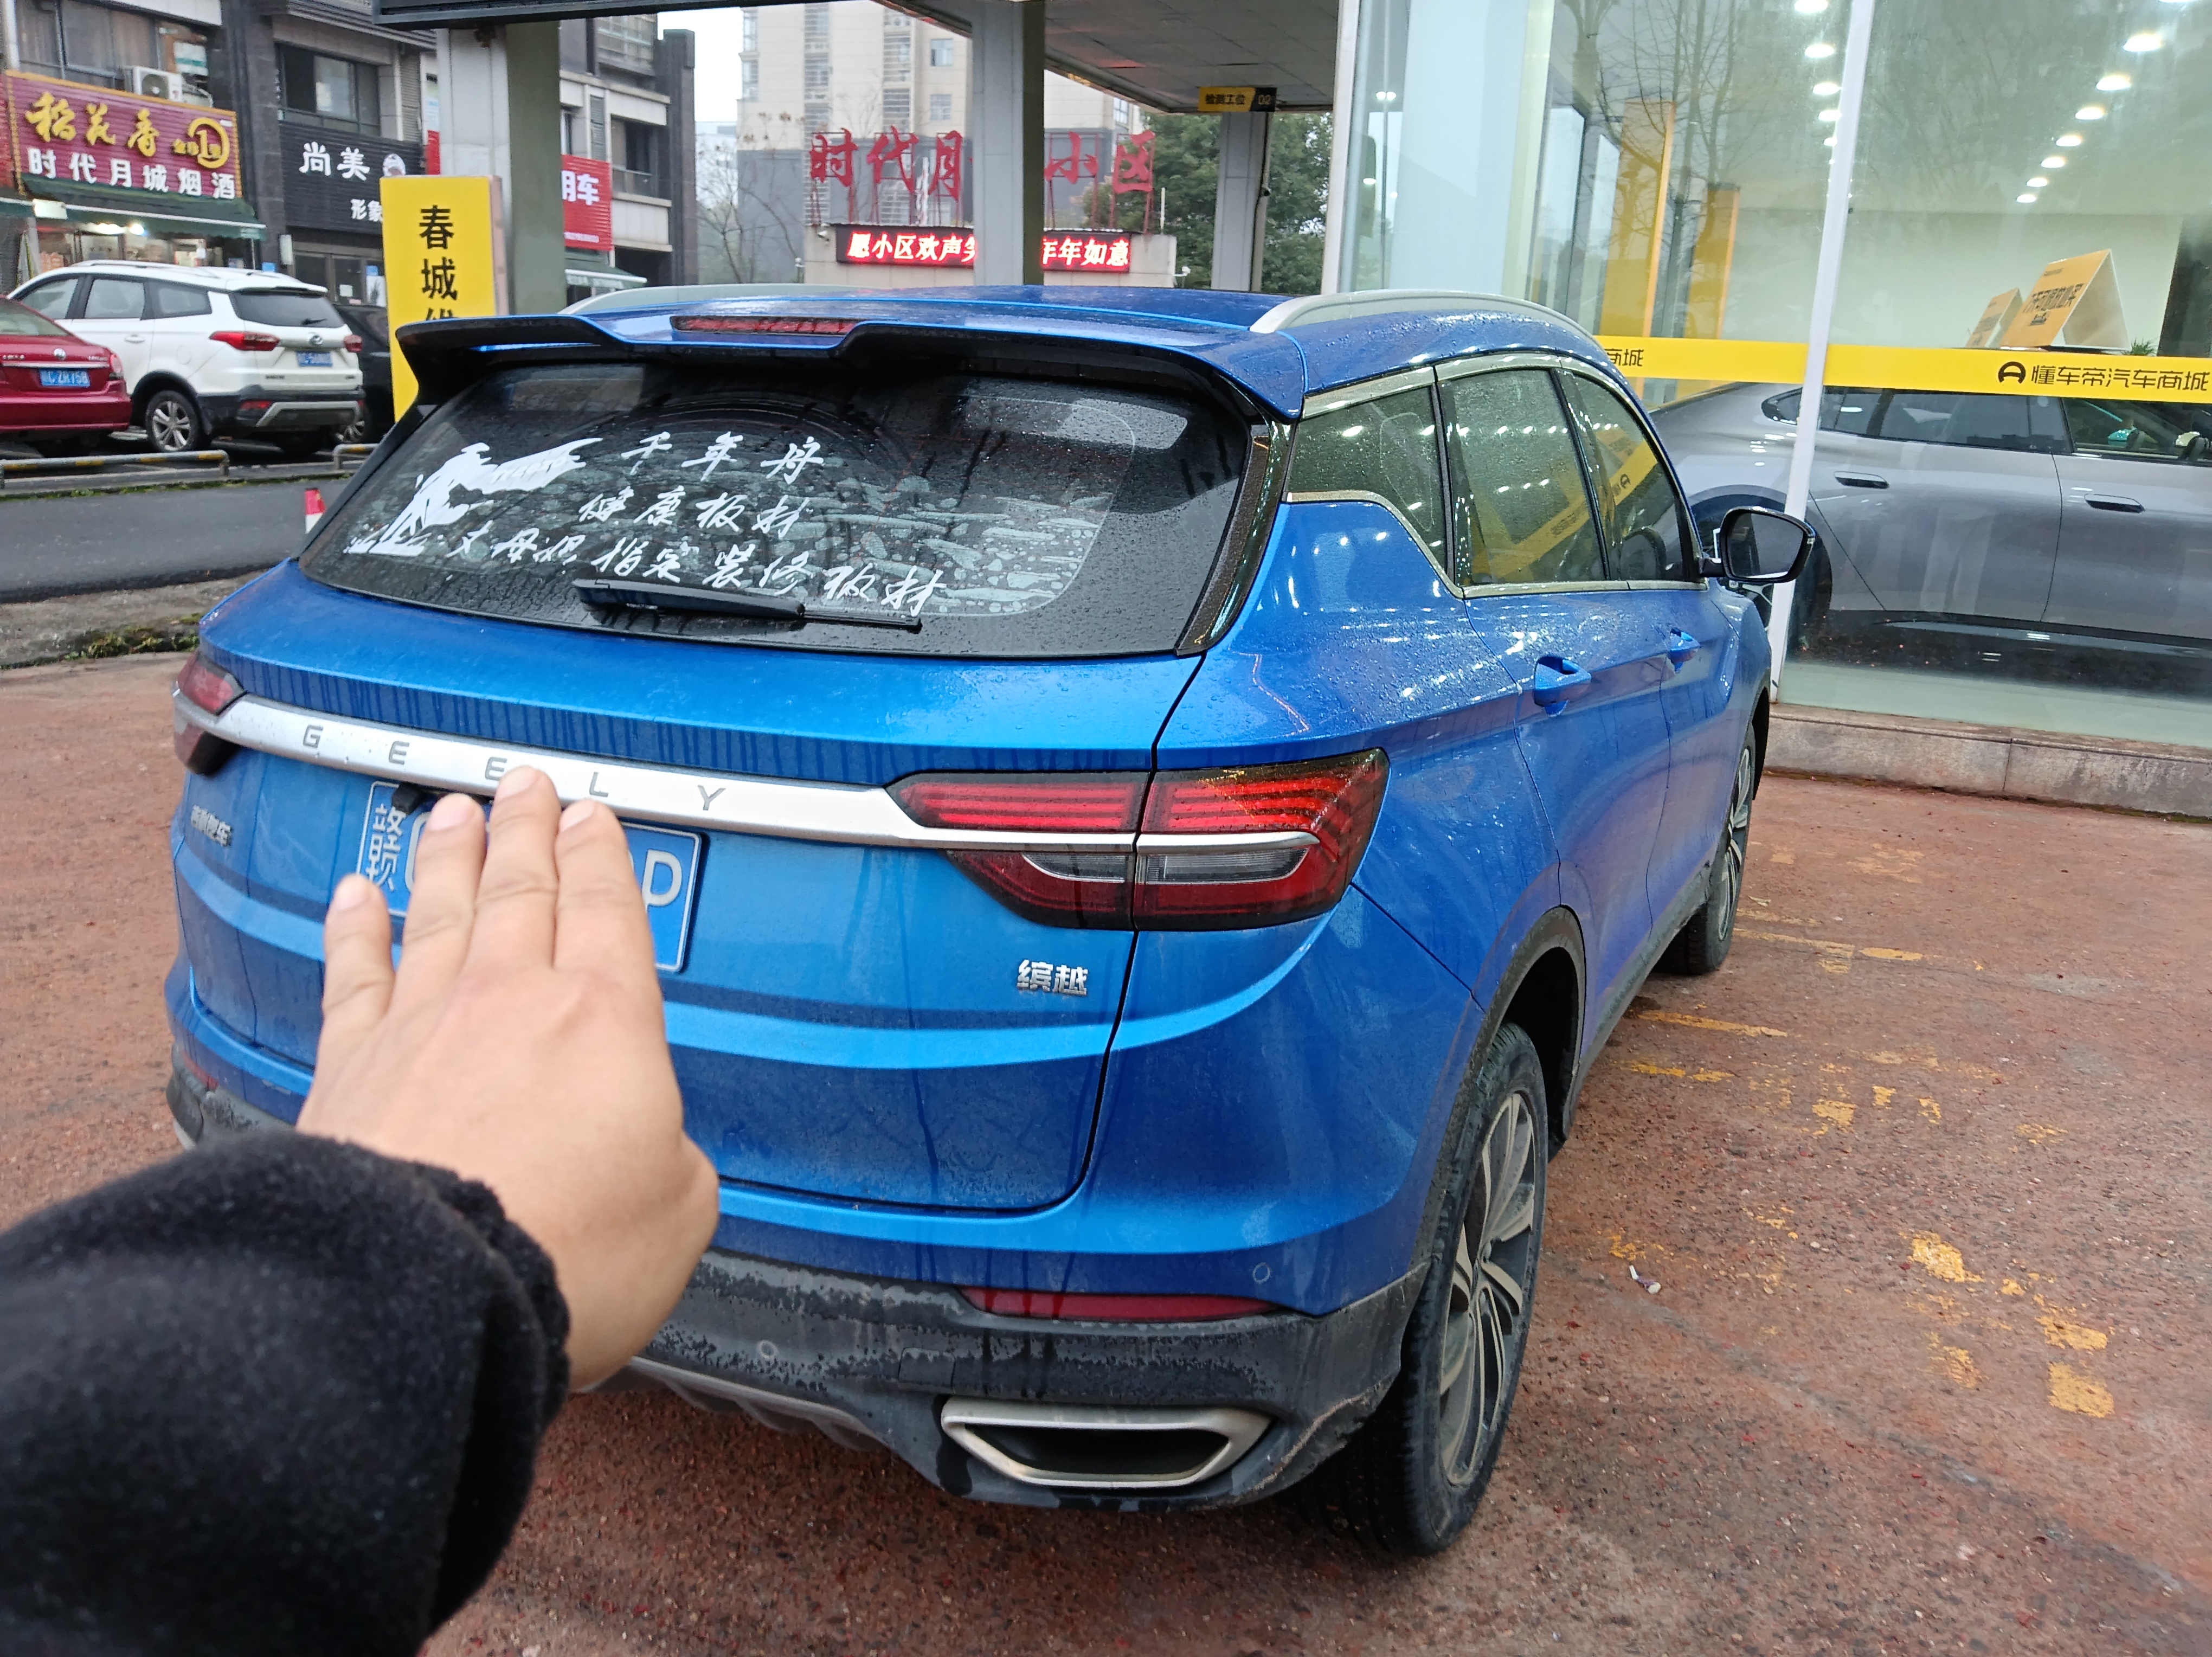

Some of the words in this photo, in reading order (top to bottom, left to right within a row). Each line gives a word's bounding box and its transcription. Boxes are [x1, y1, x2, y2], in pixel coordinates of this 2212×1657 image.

[27, 147, 236, 200] 时代月城烟酒
[299, 141, 371, 181] 尚美
[809, 125, 974, 202] 时代月
[1044, 130, 1155, 194] 小区
[419, 204, 459, 320] 春城
[2031, 364, 2211, 391] 懂车帝汽车商城
[302, 724, 726, 811] GEELY
[1017, 959, 1088, 996] 缤越
